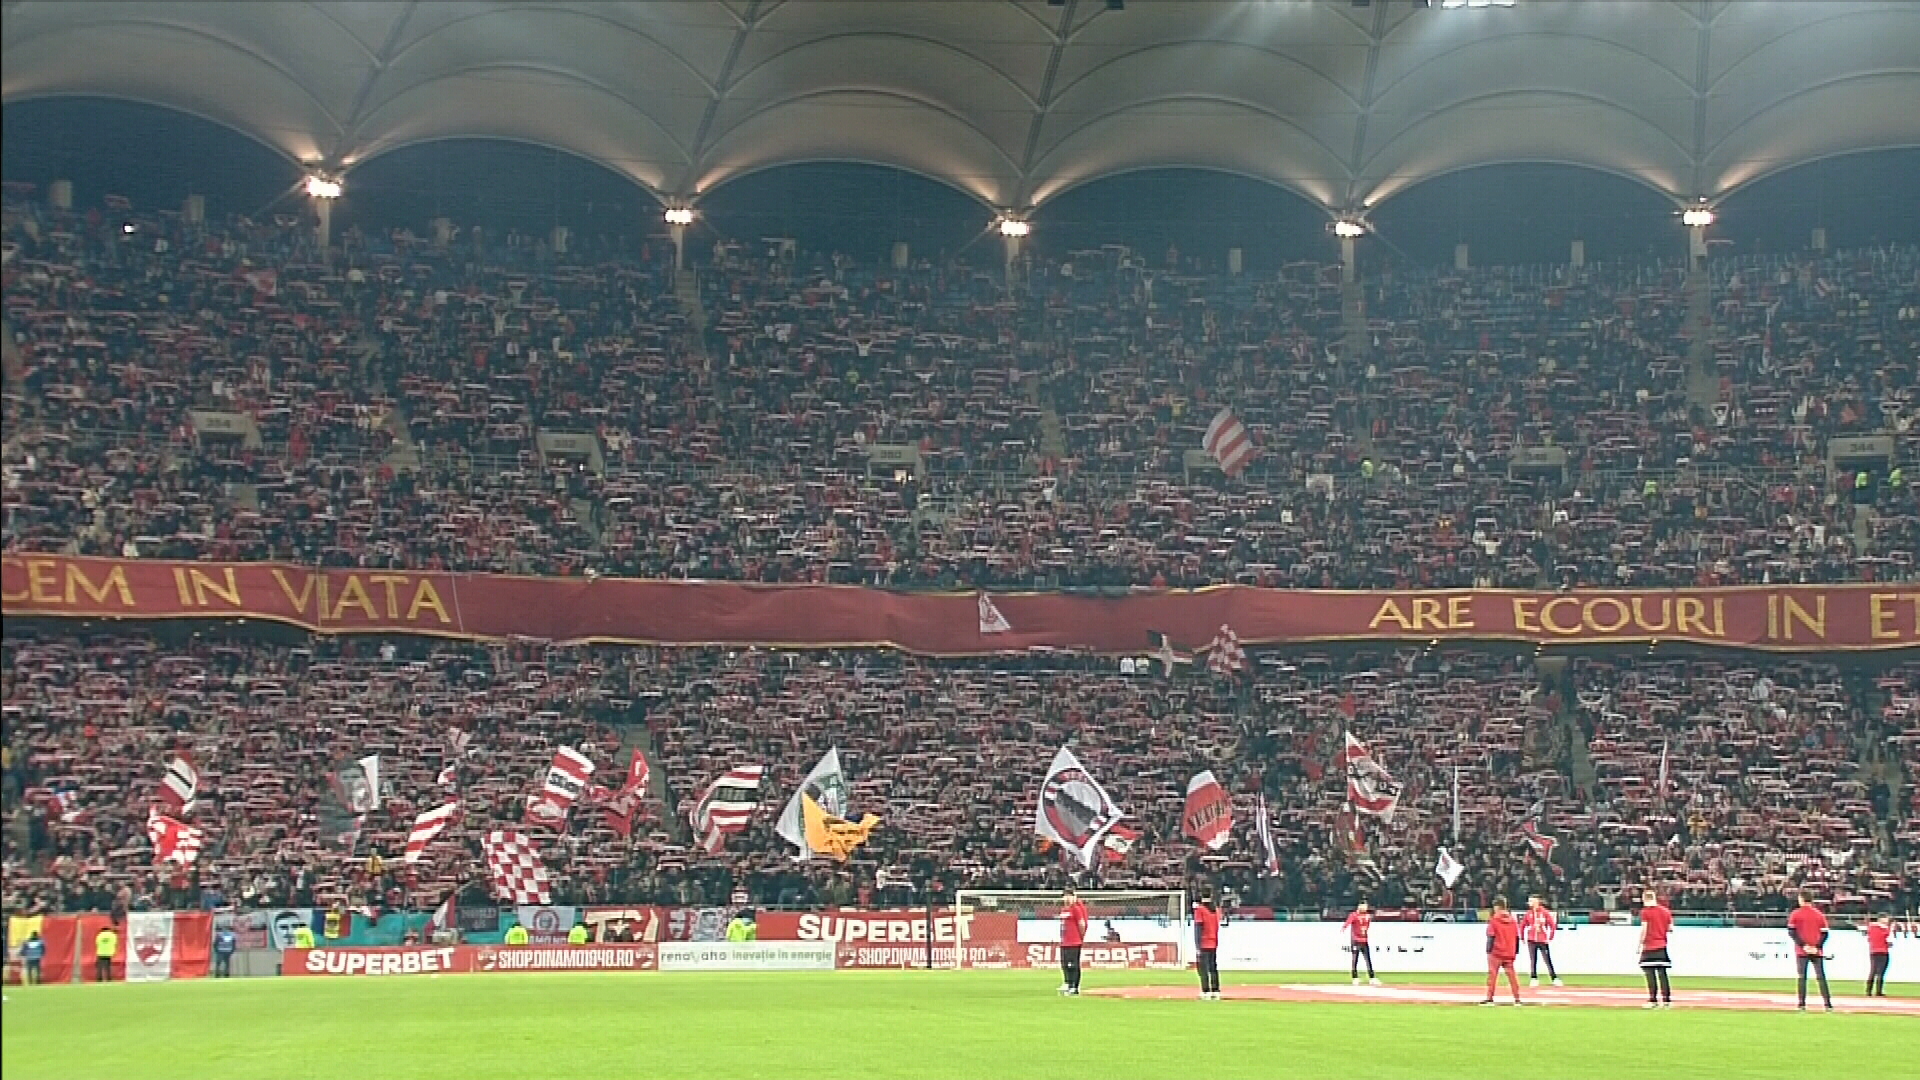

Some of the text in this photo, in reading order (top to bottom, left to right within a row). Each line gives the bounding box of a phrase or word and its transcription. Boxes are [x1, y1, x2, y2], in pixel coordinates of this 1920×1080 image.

[173, 567, 241, 606] IN
[272, 569, 451, 623] VIATA
[1369, 596, 1475, 630] ARE
[1513, 597, 1725, 637] ECOURI
[1768, 594, 1825, 639] IN
[797, 913, 975, 943] SUPERBET
[305, 947, 455, 975] SUPERBET
[1026, 944, 1158, 963] SUERBET
